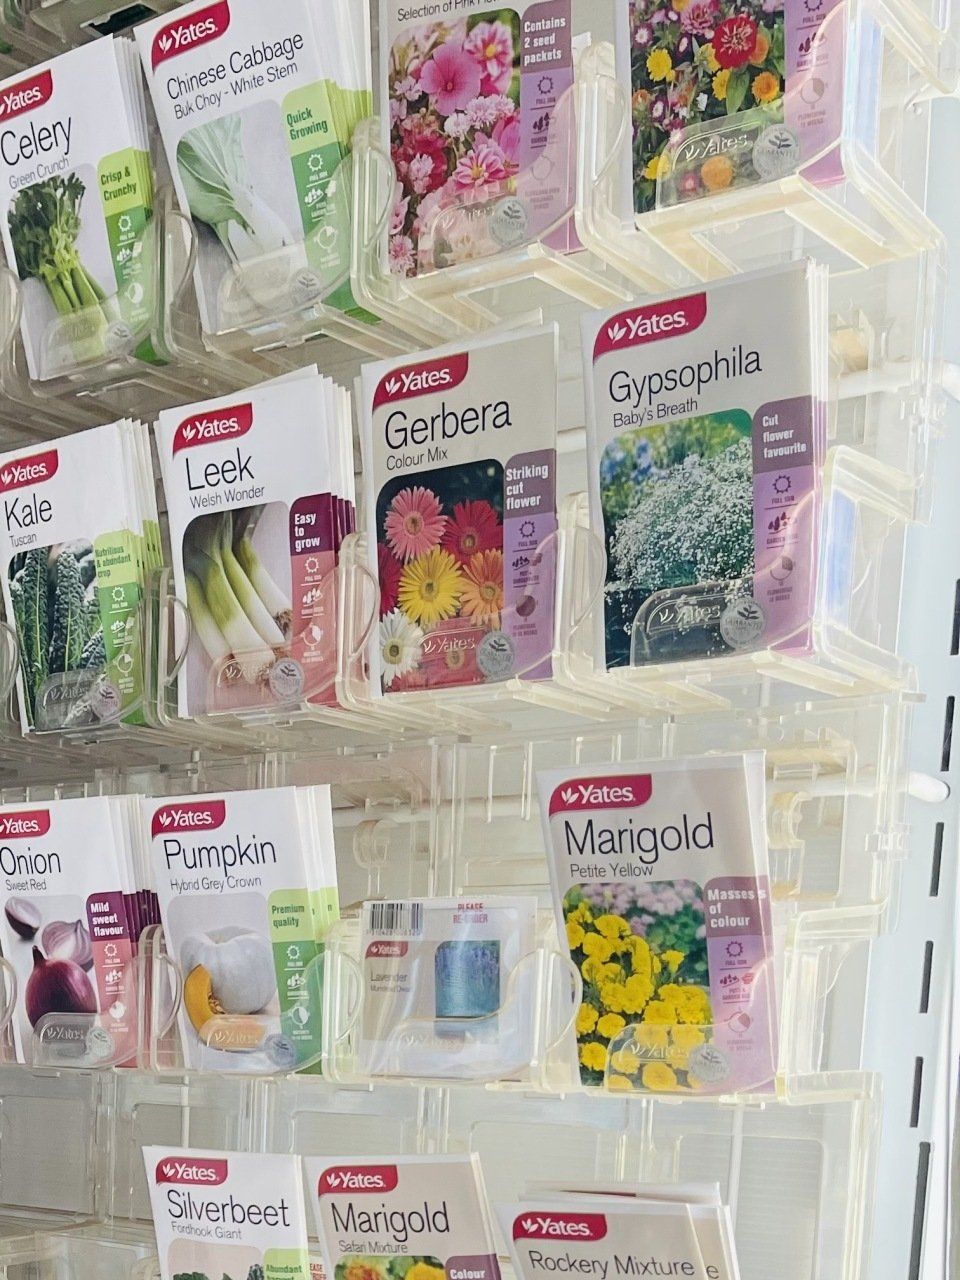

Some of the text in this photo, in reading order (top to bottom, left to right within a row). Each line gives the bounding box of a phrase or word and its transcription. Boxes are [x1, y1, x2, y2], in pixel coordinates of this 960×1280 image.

[171, 17, 218, 46] Yates
[524, 15, 566, 35] Contains
[524, 33, 556, 49] 2 seed
[166, 31, 304, 100] Chinese Cabbage
[523, 47, 563, 67] packets
[173, 61, 298, 120] Buk Choy White Stem
[286, 108, 313, 126] Quick
[0, 115, 73, 166] Celery
[289, 119, 329, 141] Growing
[627, 312, 688, 340] Yates
[402, 368, 453, 392] Yates
[610, 346, 762, 407] Gypsophila
[613, 398, 698, 428] Baby's Breath
[385, 401, 512, 450] Gerbera
[185, 448, 255, 491] Leek
[386, 447, 448, 470] Colour Mix
[506, 464, 548, 481] Striking
[190, 484, 265, 509] Welsh Wonder
[507, 494, 540, 510] flower
[4, 493, 53, 531] Kale
[579, 784, 636, 805] Yates
[564, 812, 714, 864] Marigold
[0, 846, 61, 876] Onion
[163, 837, 277, 877] Pumpkin
[570, 862, 654, 878] Petite Yellow
[90, 902, 109, 914] Mild
[271, 903, 305, 916] Premium
[92, 914, 118, 926] sweet
[93, 924, 124, 937] flavour
[370, 972, 408, 984] Lavender
[167, 1189, 291, 1228] Silverbeet
[331, 1201, 450, 1243] Marigold
[537, 1217, 593, 1237] Yates
[339, 1241, 408, 1254] Safari Mixture
[450, 1268, 486, 1280] Colour
[529, 1250, 695, 1280] Rockery Mixture
